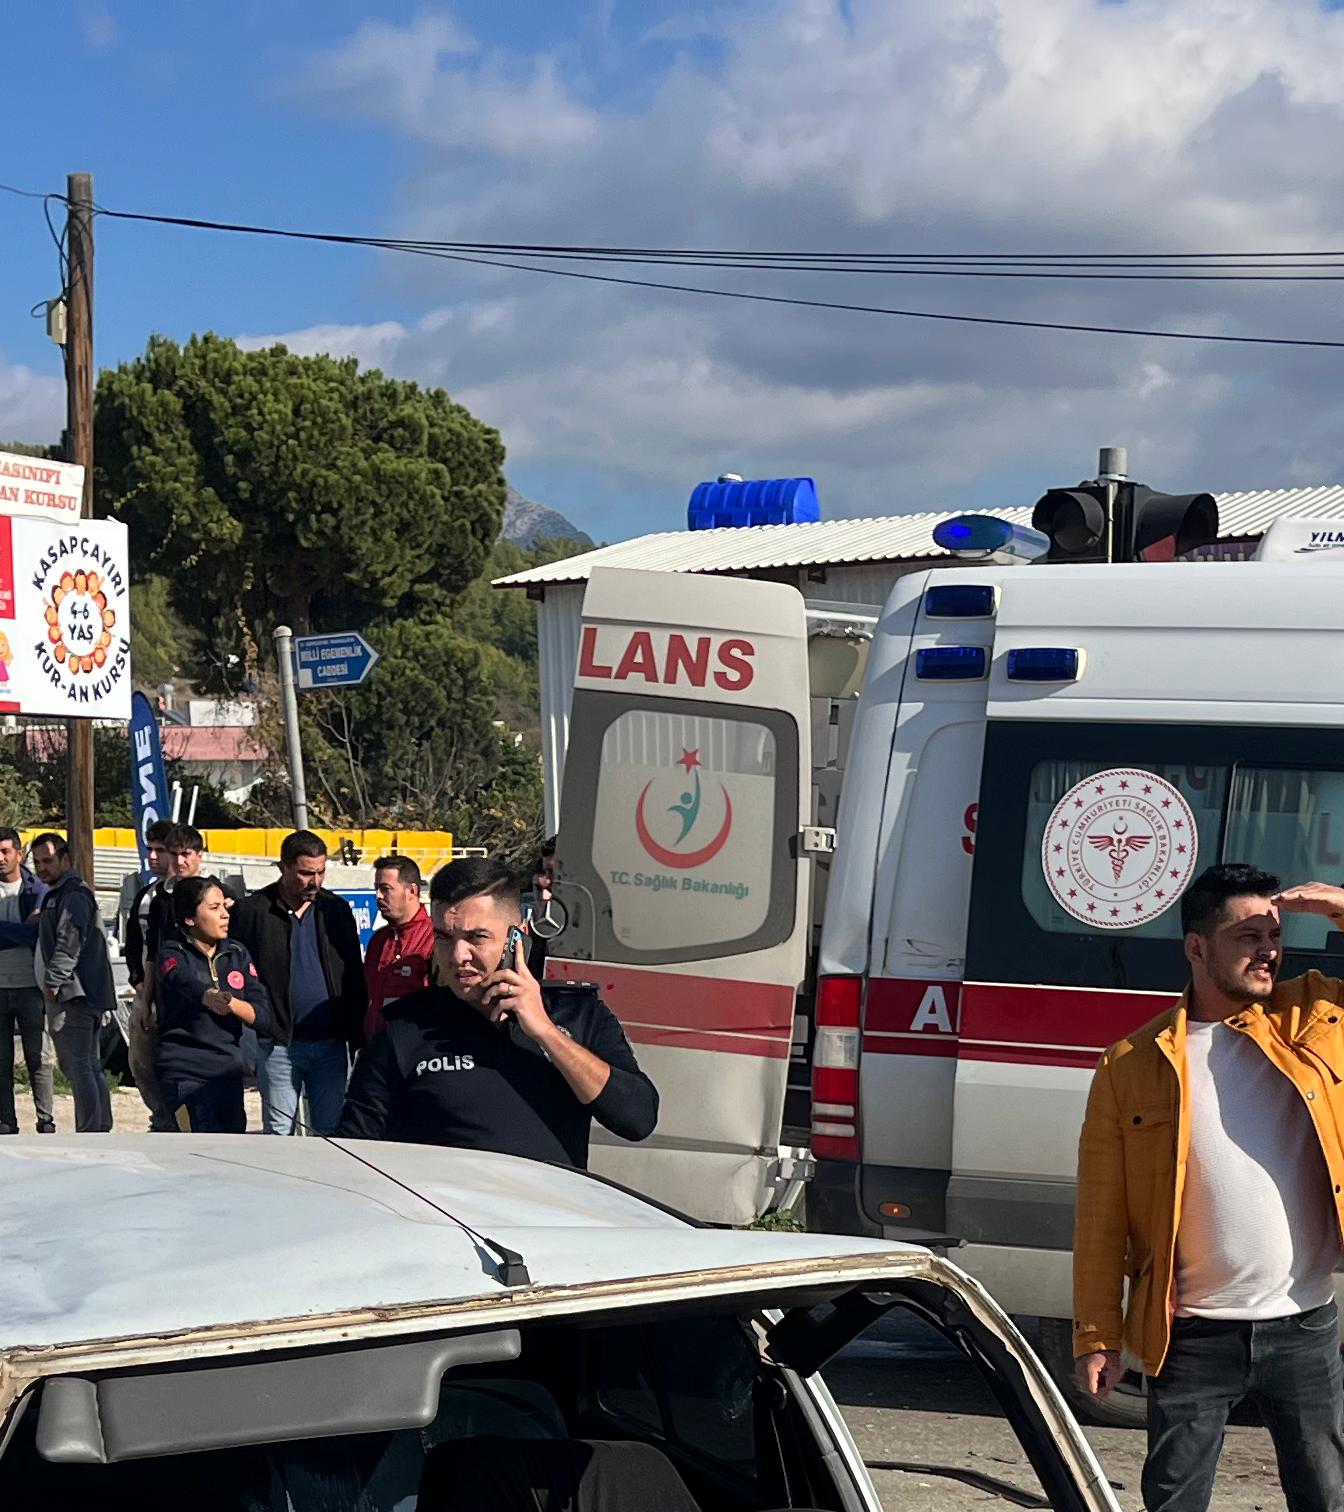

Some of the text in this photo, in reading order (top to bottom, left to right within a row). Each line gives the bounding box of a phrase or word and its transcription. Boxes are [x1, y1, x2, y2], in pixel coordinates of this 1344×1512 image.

[23, 488, 78, 511] KURSU
[31, 536, 126, 597] KASAPÇAYIRI
[70, 601, 90, 620] 4-6
[67, 624, 94, 644] YAŞ
[578, 626, 756, 692] LANS
[633, 872, 678, 892] Sağlık
[681, 877, 750, 900] Bakanlığı
[910, 984, 953, 1033] A
